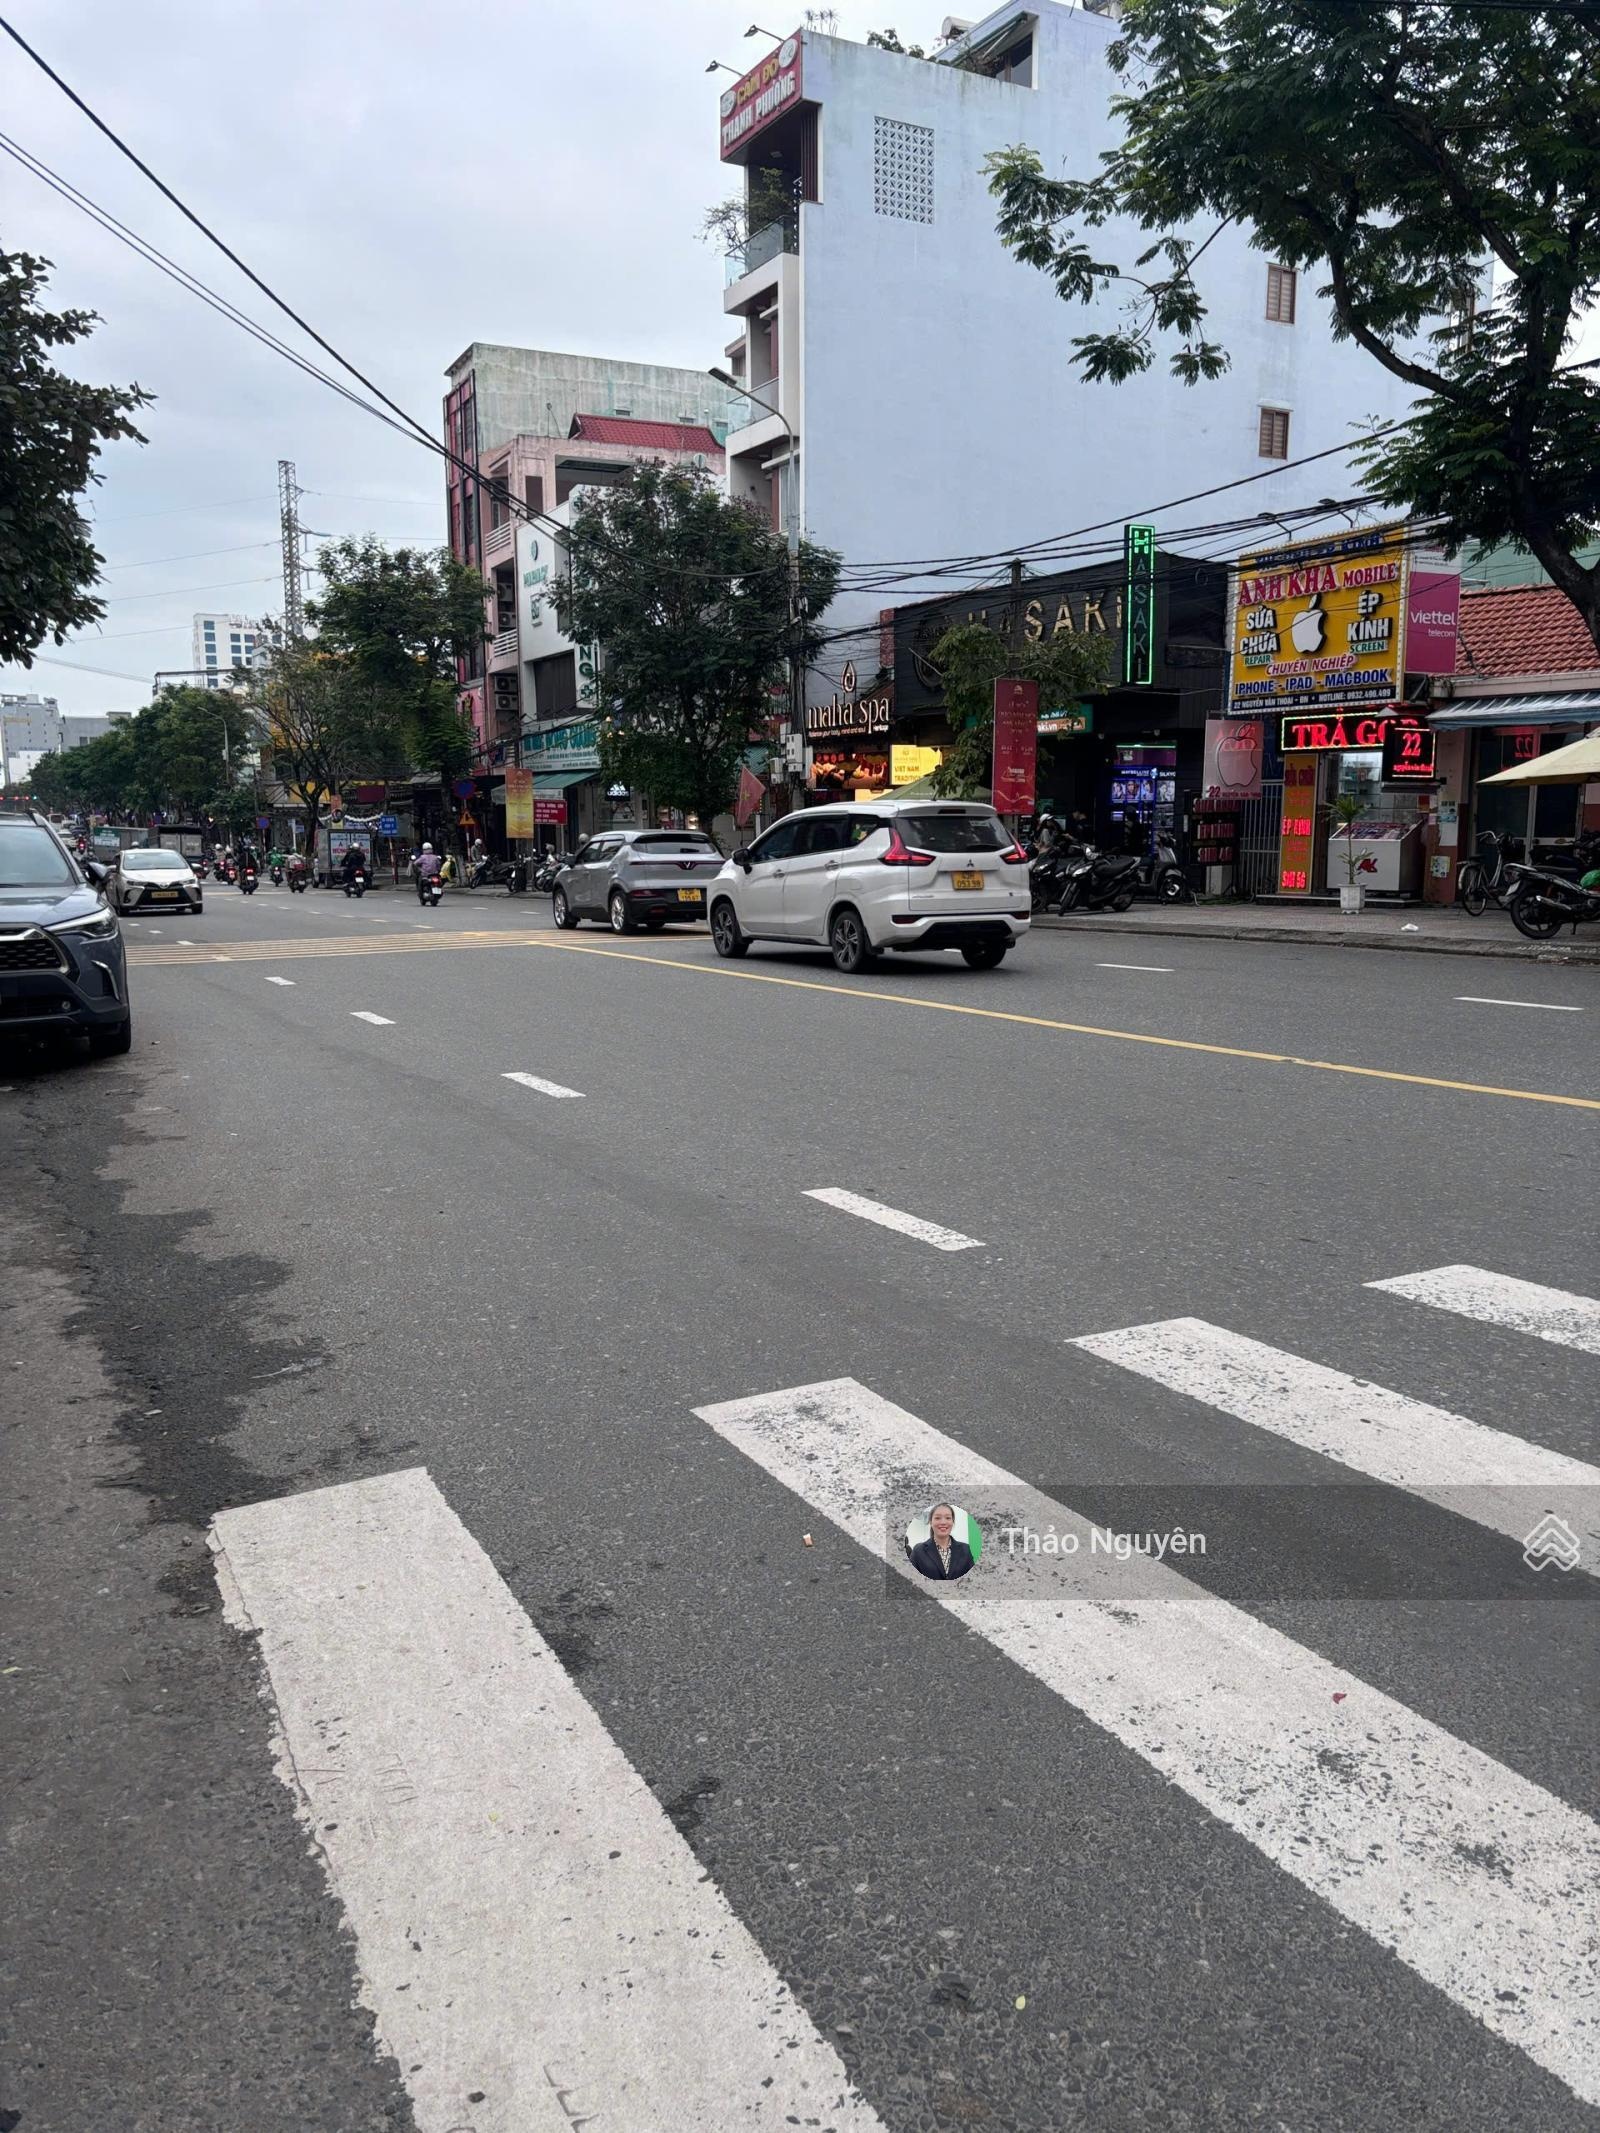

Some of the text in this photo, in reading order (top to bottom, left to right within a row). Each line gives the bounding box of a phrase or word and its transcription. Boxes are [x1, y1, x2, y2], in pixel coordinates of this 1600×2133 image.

[722, 104, 753, 147] THANH
[1238, 563, 1397, 606] ANH KHA MOBILE
[1133, 530, 1150, 680] HASAKI
[1358, 590, 1381, 615] ÉP
[1246, 605, 1275, 630] SỬA
[1347, 616, 1390, 642] KÍNH
[1411, 611, 1456, 625] viettel
[1240, 632, 1278, 655] CHỮA
[1428, 628, 1455, 638] telecom
[1244, 654, 1271, 665] REPAIR
[1350, 642, 1385, 653] SCREEN
[1266, 655, 1355, 677] CHUYÊN NGHIỆP
[1235, 679, 1274, 695] IPHONE
[1285, 675, 1313, 691] IPAD
[1325, 669, 1389, 687] MACBOOK
[808, 694, 889, 734] maha spa
[1292, 716, 1348, 749] TRẢ
[1402, 732, 1421, 757] 22
[1208, 785, 1221, 798] 22
